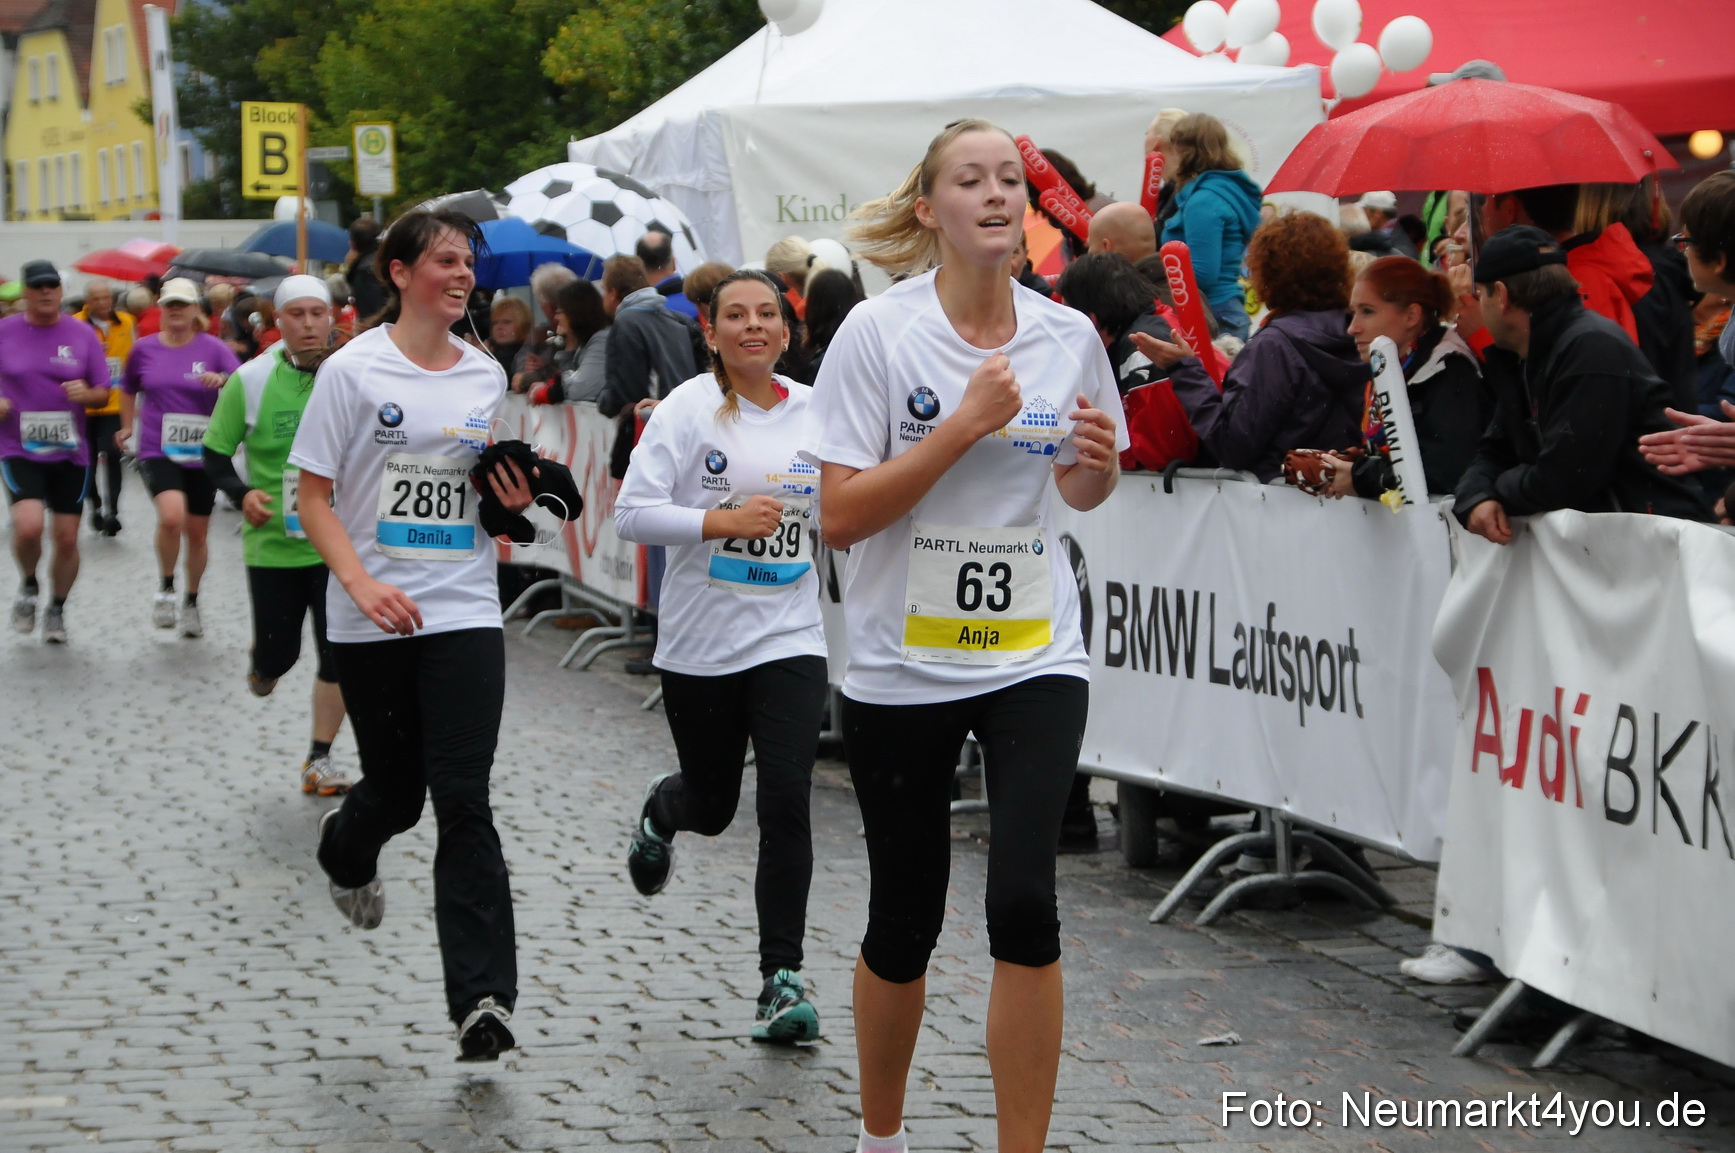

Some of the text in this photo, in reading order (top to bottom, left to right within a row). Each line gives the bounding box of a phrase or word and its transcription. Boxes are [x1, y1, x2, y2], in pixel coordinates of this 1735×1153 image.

[250, 106, 298, 123] Block
[262, 132, 289, 175] B
[27, 424, 70, 441] 2045
[375, 429, 408, 440] PARTL
[900, 421, 937, 435] PART
[899, 432, 924, 443] Neum
[386, 461, 466, 477] PARTL Neumarkt
[284, 476, 299, 484] PAR
[702, 476, 731, 486] PARTL
[765, 473, 781, 484] 14.
[702, 484, 731, 492] Neumarkt
[389, 480, 466, 519] 2881
[407, 528, 452, 546] Danila
[914, 536, 1029, 554] PARTL Neumarkt
[747, 566, 778, 583] Nina
[956, 561, 1012, 612] 63
[957, 625, 1000, 649] Anja
[1105, 580, 1365, 728] BMW Laufsport
[1471, 667, 1735, 861] Audi BKK
